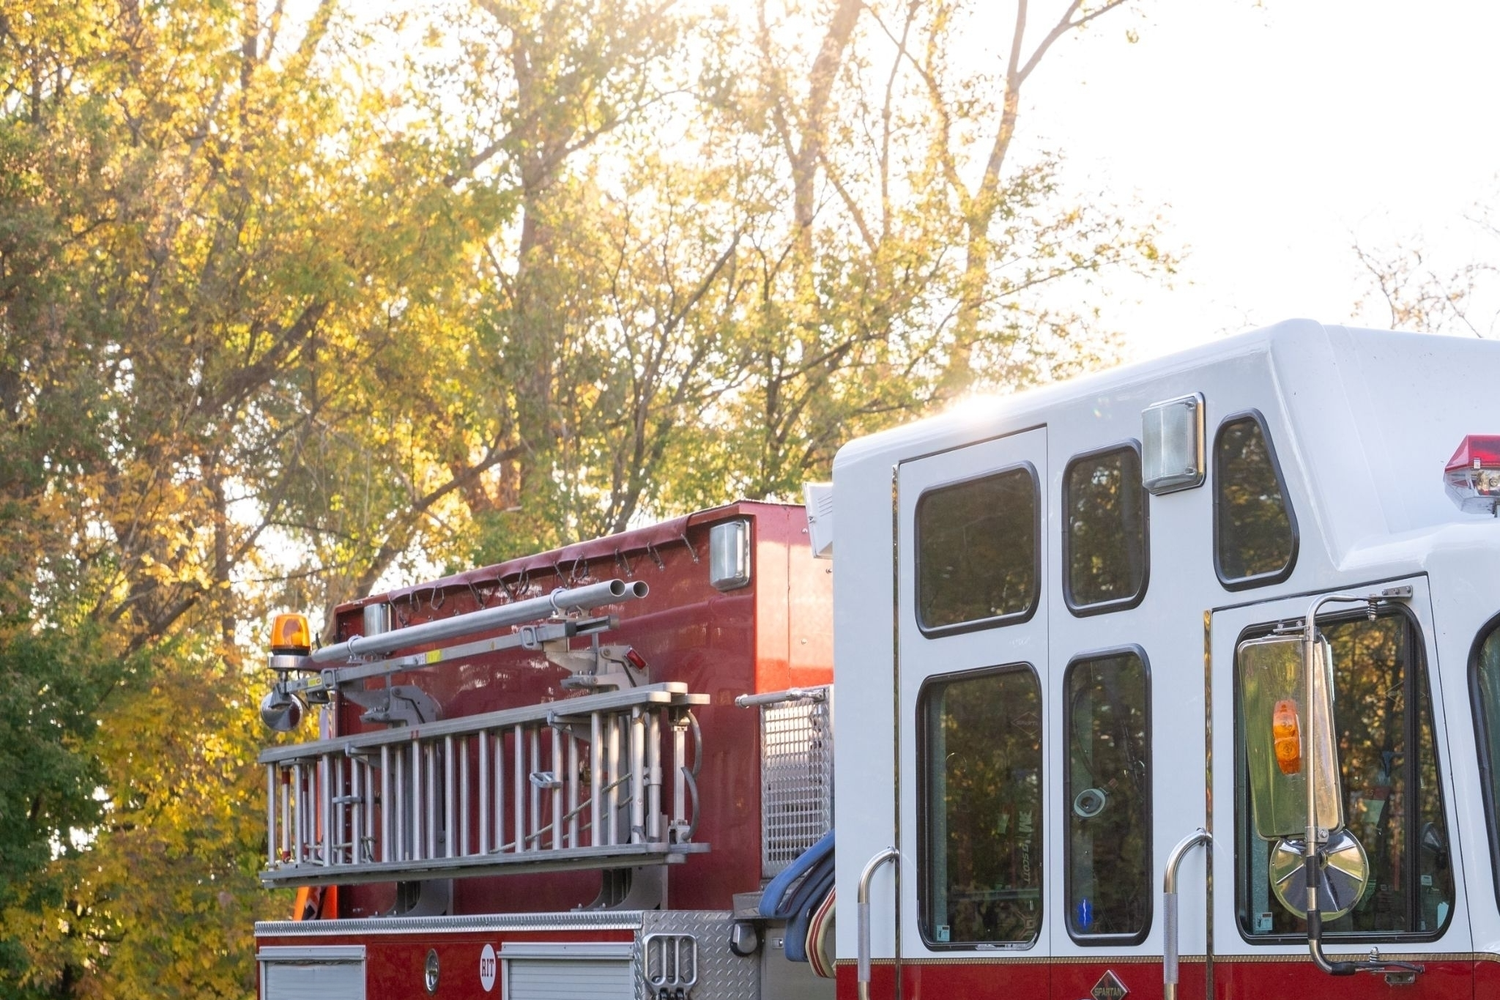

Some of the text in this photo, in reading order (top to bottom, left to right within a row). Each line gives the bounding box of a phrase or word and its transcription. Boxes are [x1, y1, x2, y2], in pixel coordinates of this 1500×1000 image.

[1022, 853, 1032, 885] SCOTT
[482, 959, 494, 977] RIT
[1094, 987, 1121, 997] SPARTAN
